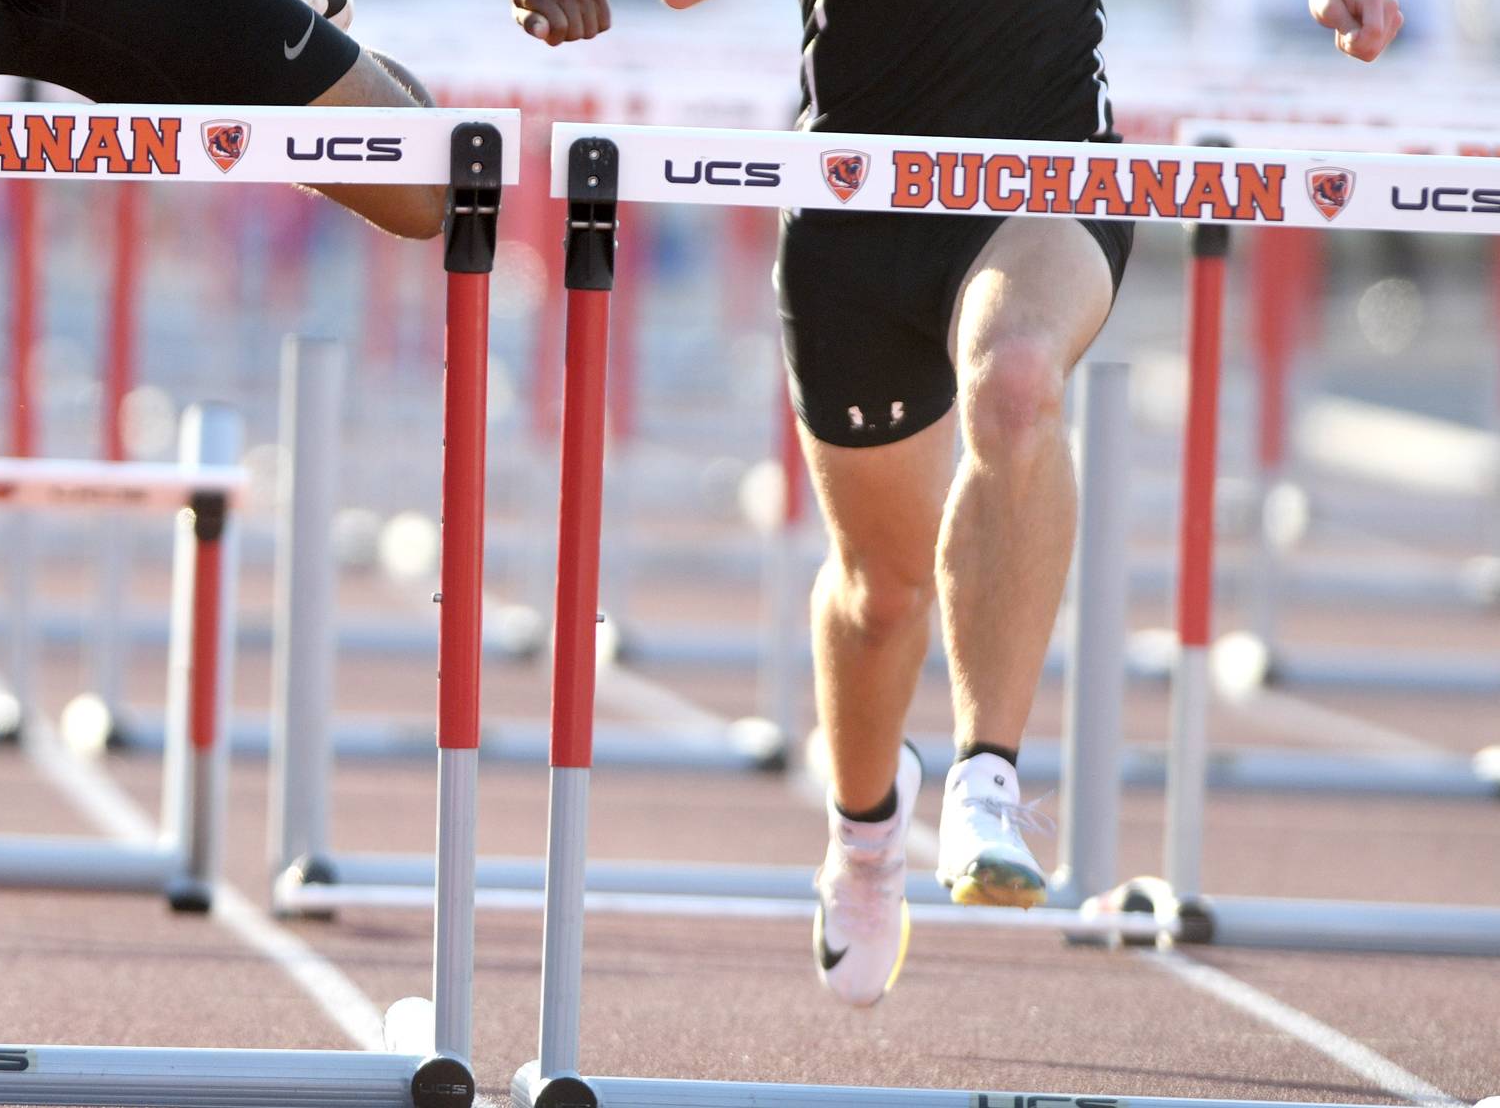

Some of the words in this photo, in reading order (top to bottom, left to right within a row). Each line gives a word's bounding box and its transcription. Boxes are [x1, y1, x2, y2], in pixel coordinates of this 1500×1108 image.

[286, 136, 403, 162] UCS
[664, 159, 781, 187] UCS
[890, 149, 1287, 222] BUCHANAN
